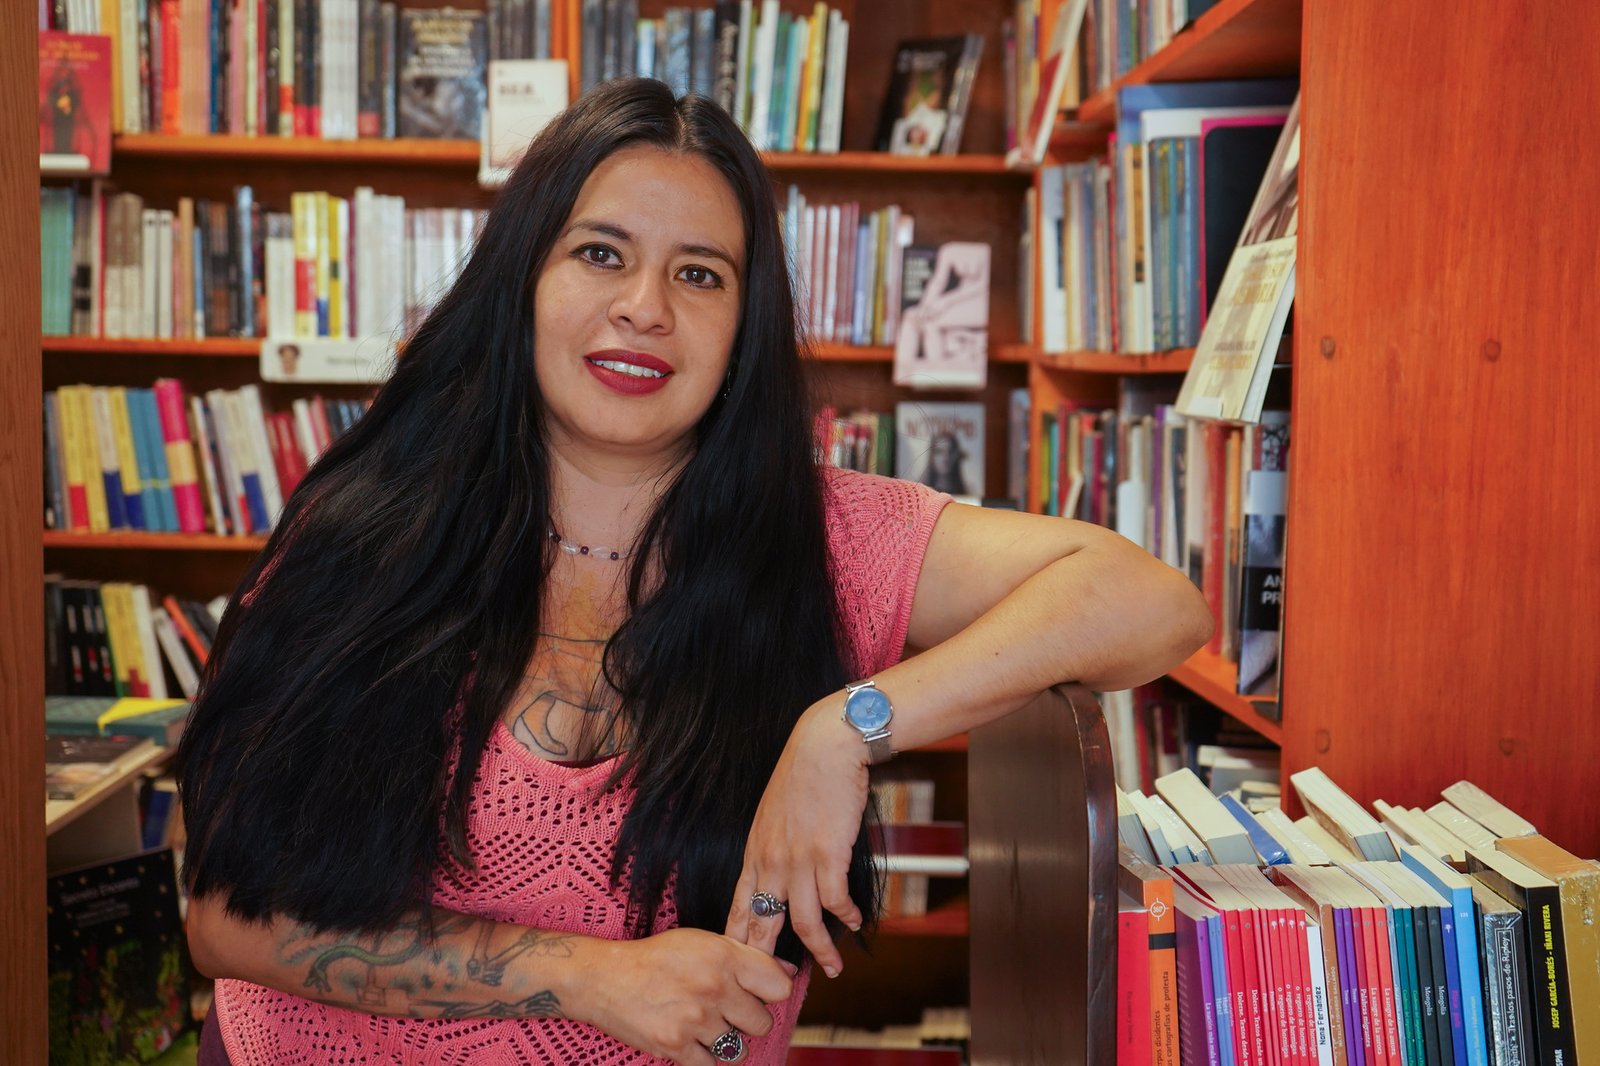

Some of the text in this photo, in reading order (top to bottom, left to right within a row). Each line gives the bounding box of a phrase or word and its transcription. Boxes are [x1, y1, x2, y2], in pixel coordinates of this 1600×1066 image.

[1542, 904, 1551, 930] RIVERA
[1501, 937, 1510, 962] Ripley
[1503, 963, 1511, 975] de
[1162, 971, 1171, 1001] protesta
[1384, 988, 1391, 996] La
[1506, 977, 1515, 1000] pasos
[1163, 1003, 1170, 1012] de
[1371, 987, 1377, 995] La
[1374, 1018, 1381, 1027] de
[1384, 996, 1392, 1018] sangre
[1424, 986, 1433, 1016] Mongolia
[1438, 985, 1447, 1015] Mongolia
[1154, 1010, 1162, 1047] disidentes
[1281, 1020, 1287, 1028] de
[1289, 1016, 1295, 1025] de
[1299, 1018, 1305, 1027] de
[1309, 1019, 1315, 1028] de
[1387, 1018, 1394, 1027] de
[1551, 1008, 1560, 1028] JOSEP
